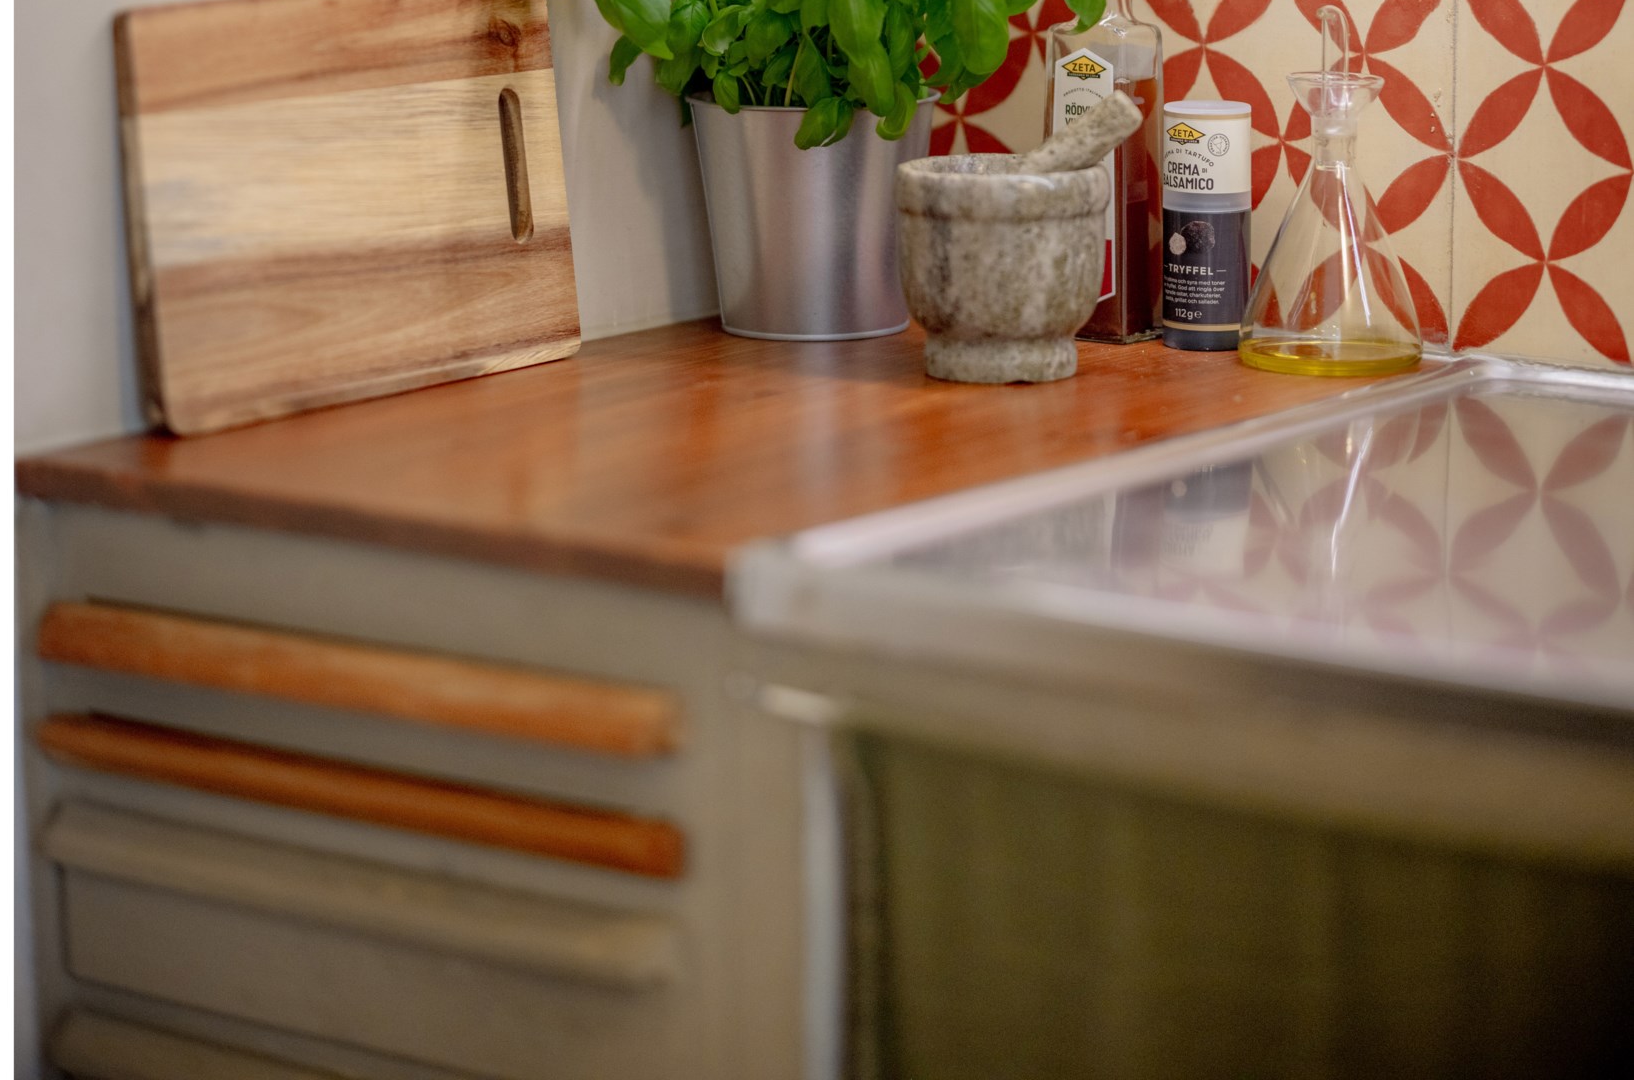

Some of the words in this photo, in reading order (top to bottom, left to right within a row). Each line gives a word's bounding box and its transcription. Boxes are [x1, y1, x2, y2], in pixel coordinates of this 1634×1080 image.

[1072, 63, 1096, 73] ZETA
[1172, 128, 1195, 138] ZETA
[1185, 149, 1215, 167] TARTUFO
[1167, 160, 1200, 177] CREMA
[1168, 263, 1214, 276] TRYFFEL
